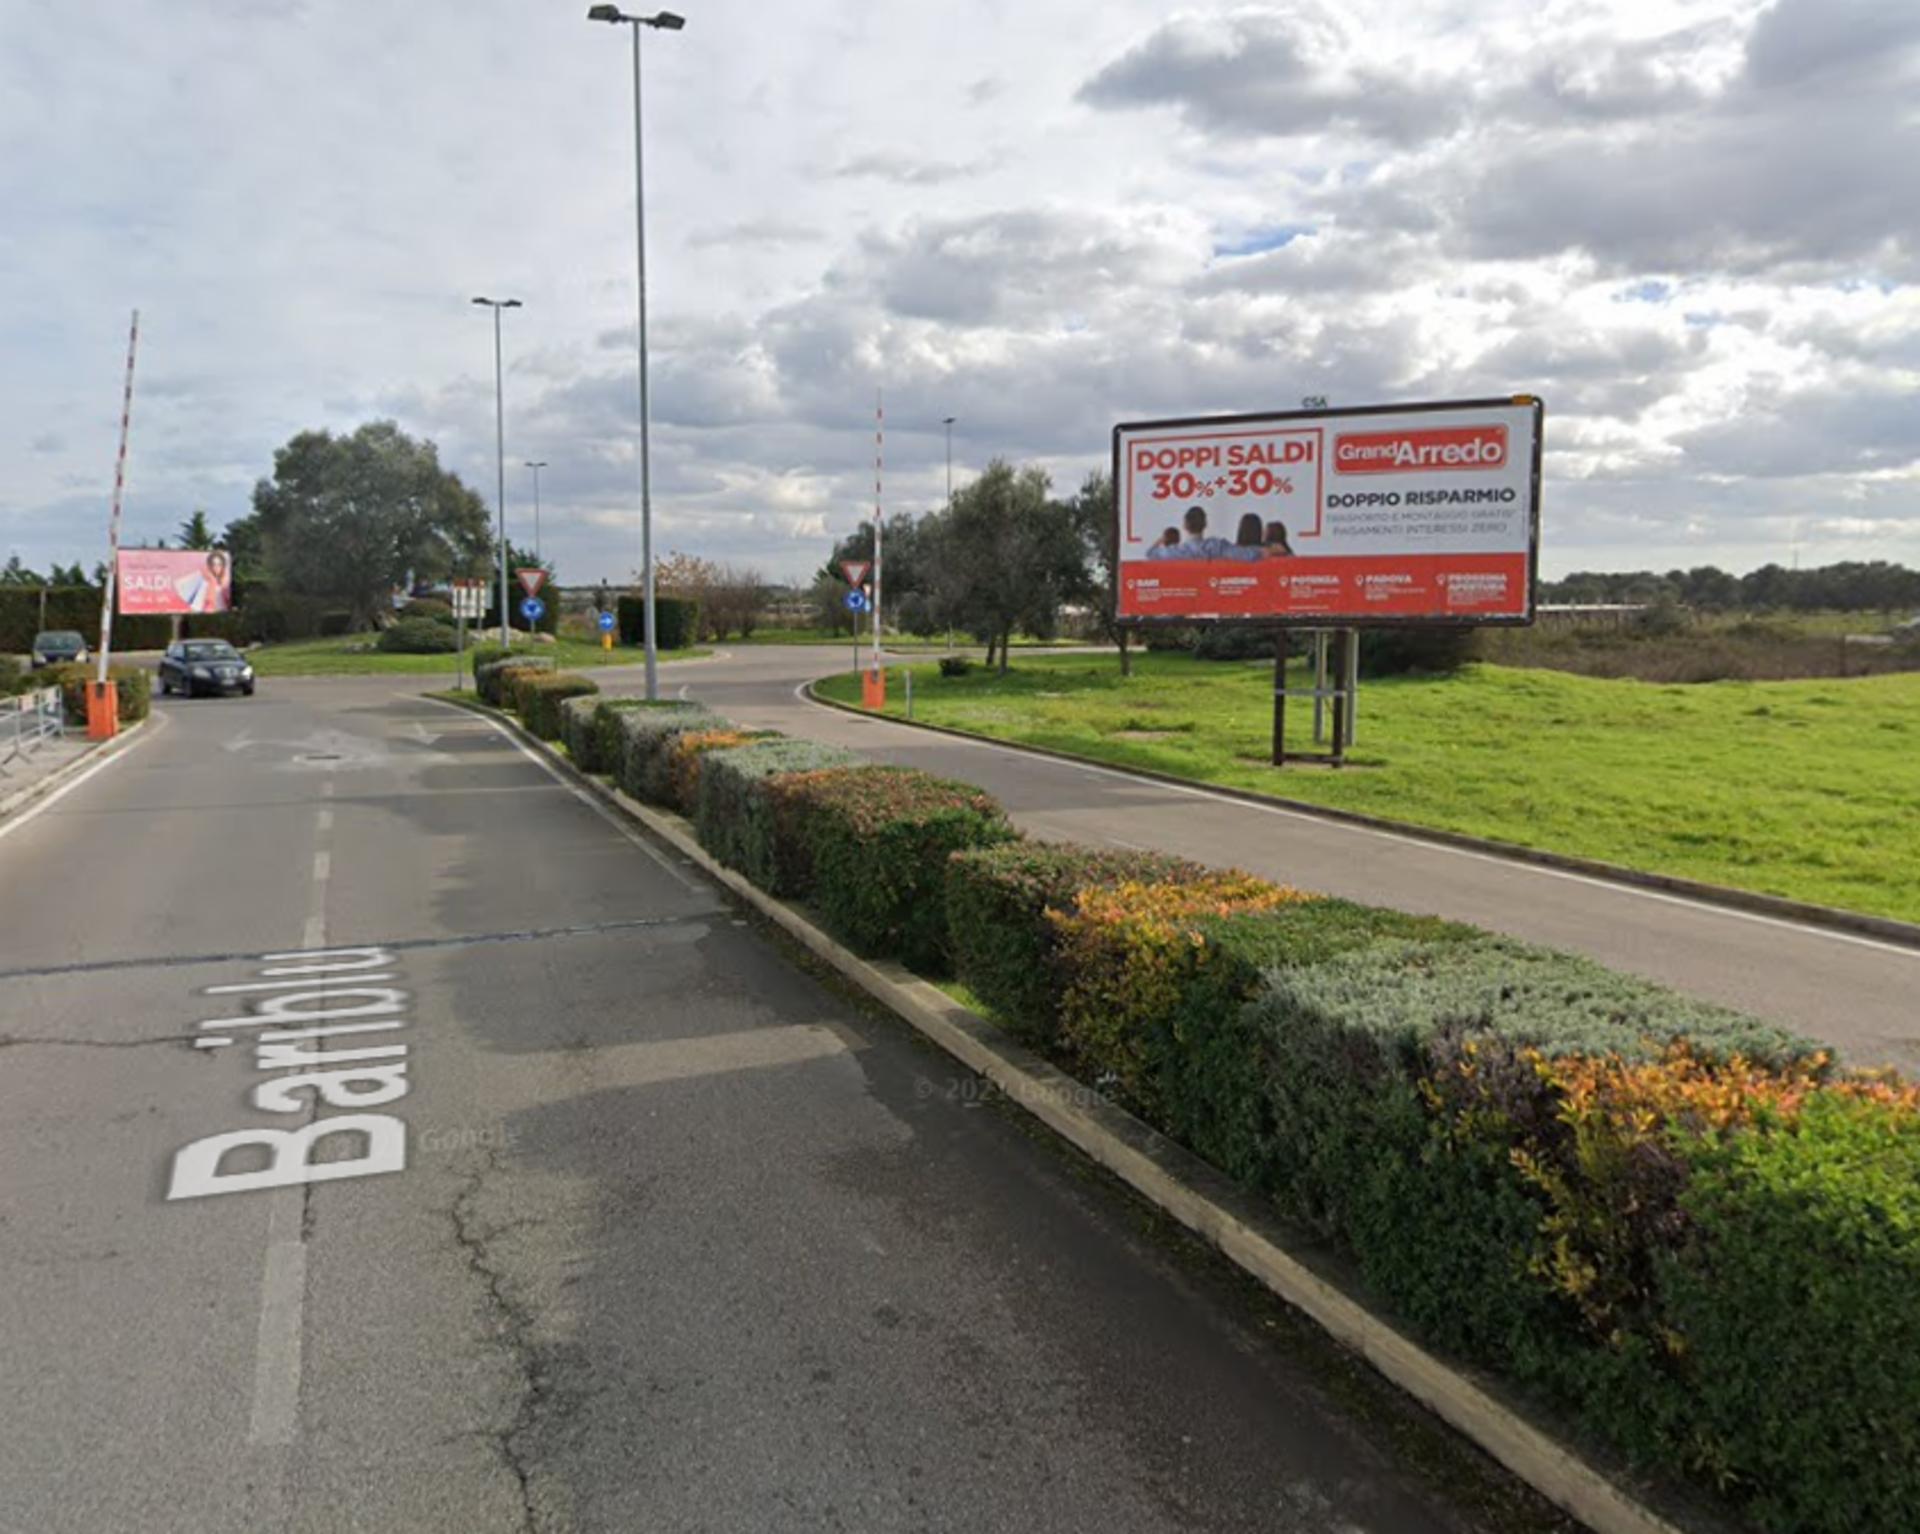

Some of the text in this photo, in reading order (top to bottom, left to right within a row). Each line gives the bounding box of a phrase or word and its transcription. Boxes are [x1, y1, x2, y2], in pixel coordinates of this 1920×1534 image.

[1137, 441, 1313, 471] DOPPI SALDI
[1327, 488, 1516, 508] DOPPIO RISPARMIO
[1333, 521, 1507, 536] PAGAMENTI INTERESSI ZERO
[123, 574, 172, 592] SALDI
